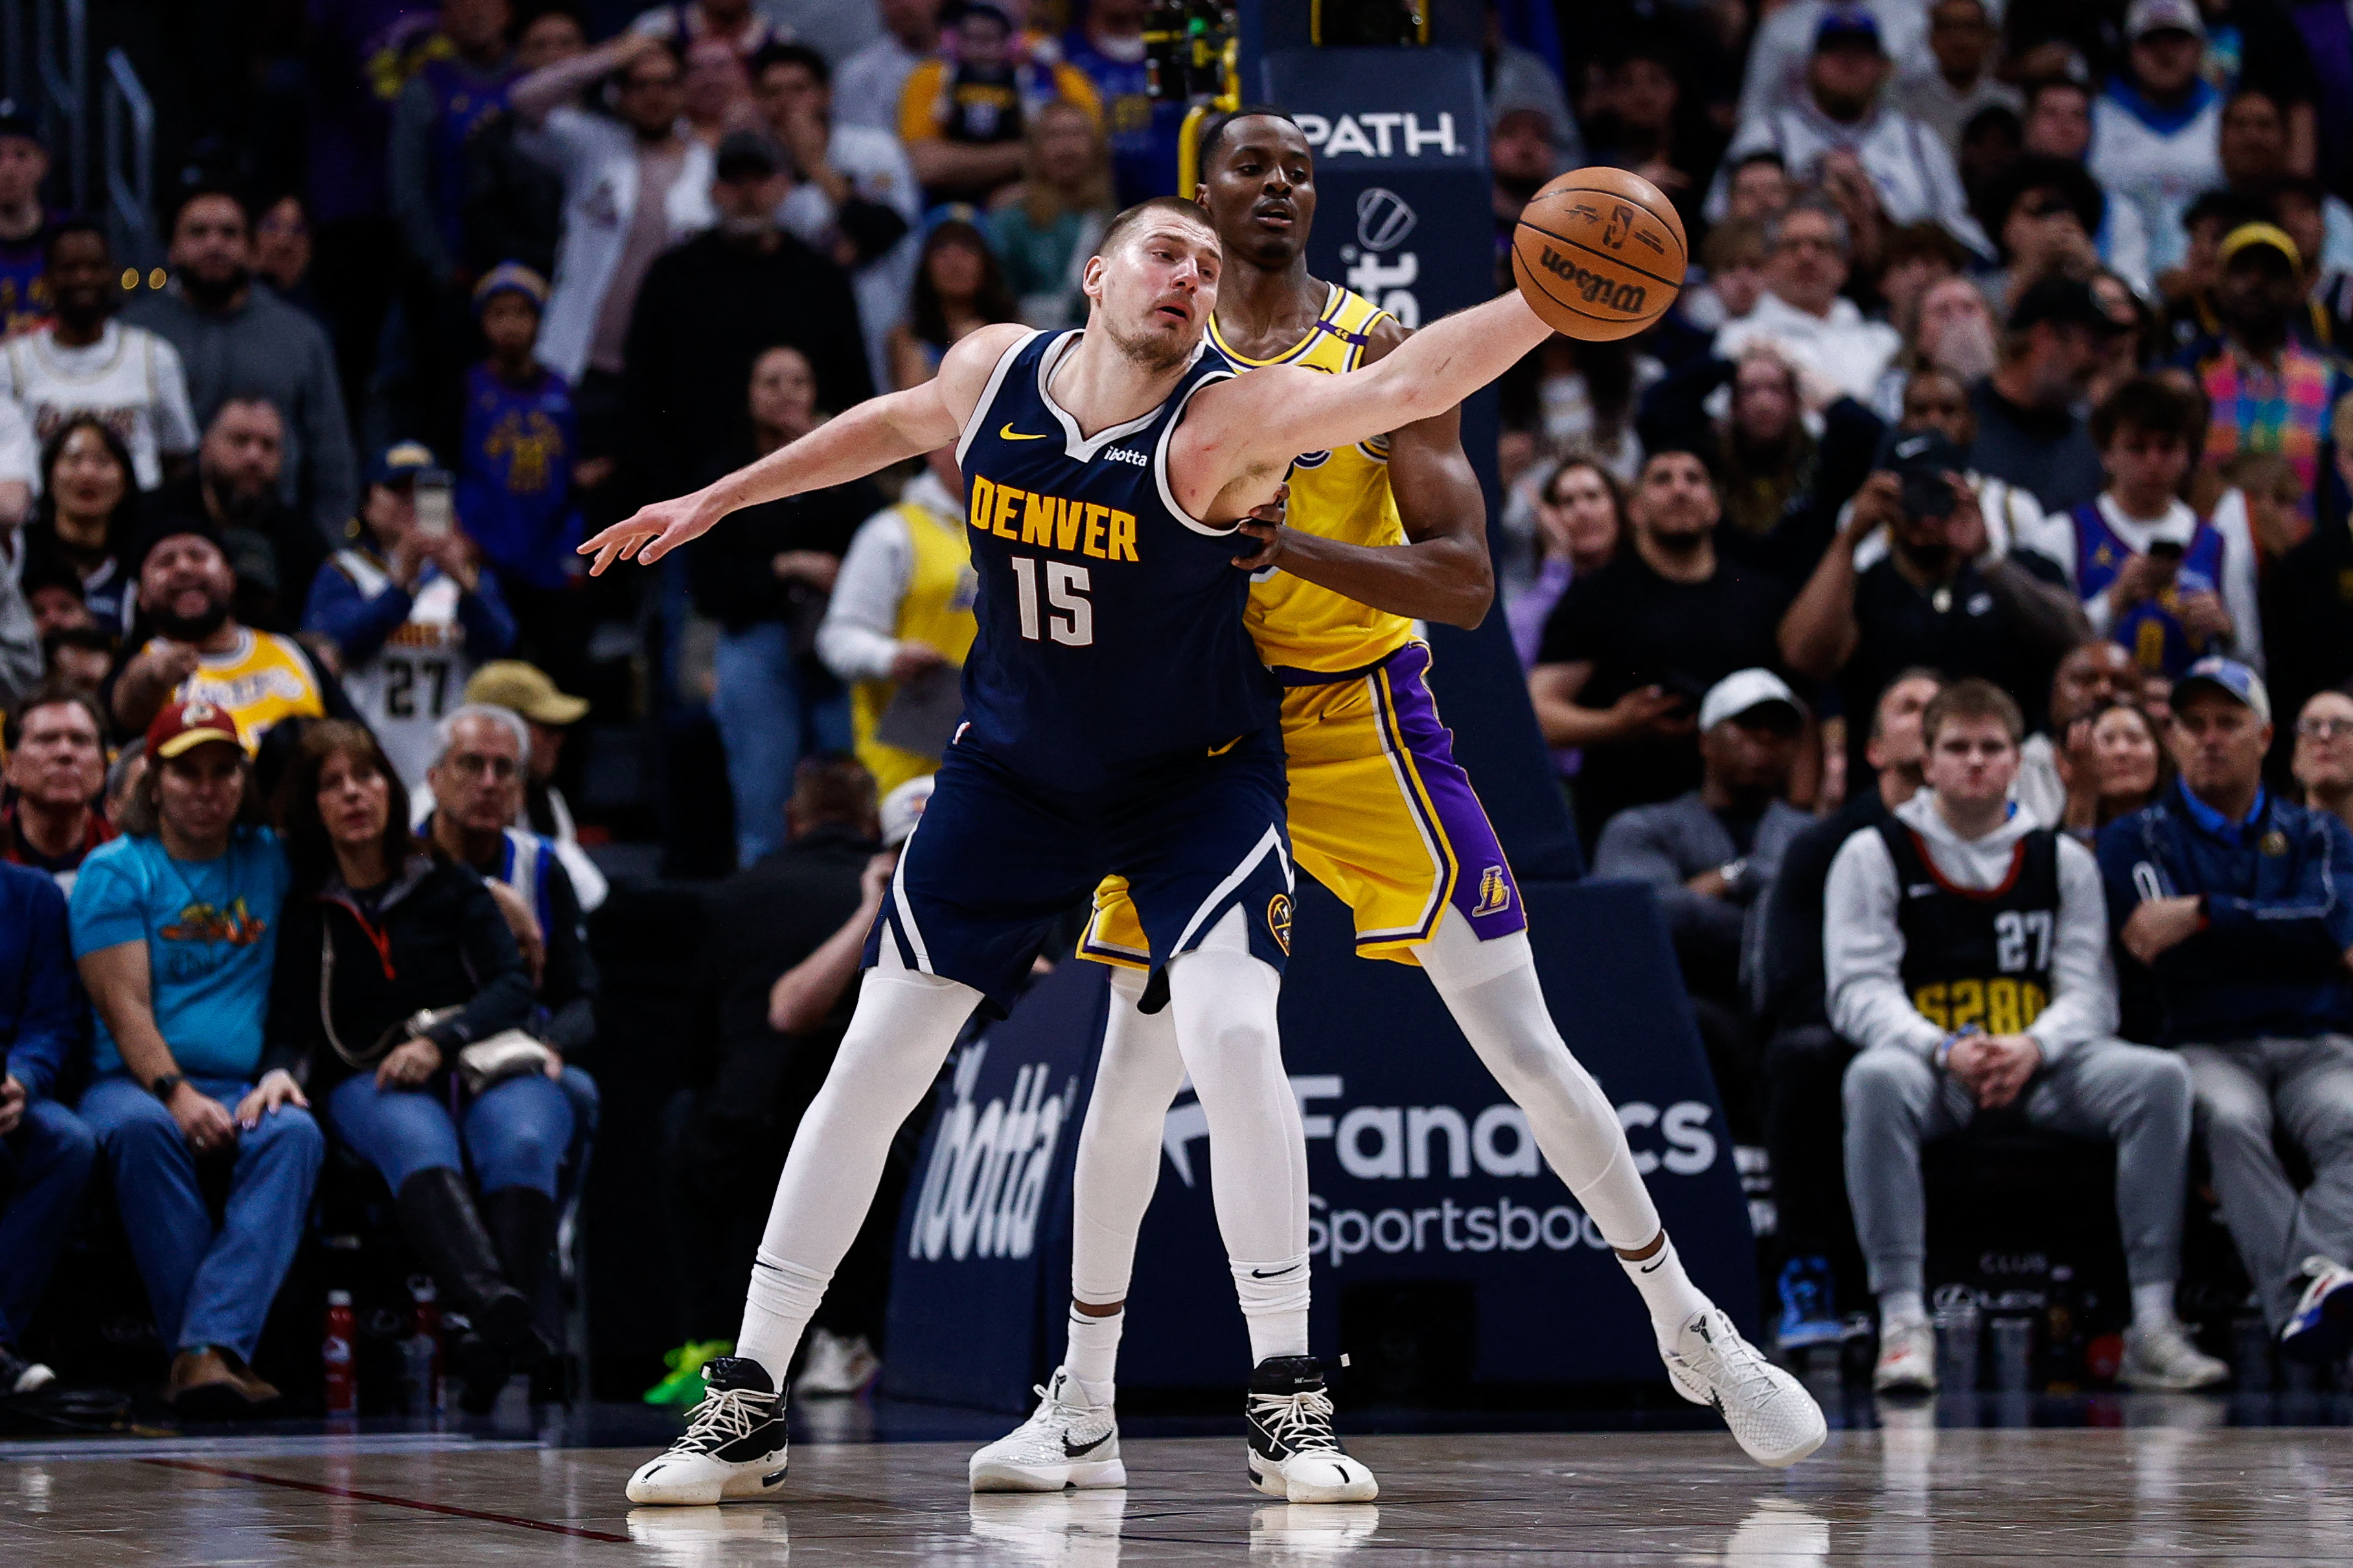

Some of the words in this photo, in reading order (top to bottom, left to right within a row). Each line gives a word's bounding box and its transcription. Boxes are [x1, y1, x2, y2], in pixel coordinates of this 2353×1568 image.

[1539, 244, 1646, 313] Wilson
[1335, 328, 1349, 340] 44
[1103, 445, 1148, 467] ibotta
[970, 473, 1140, 562] DENVER
[1011, 556, 1094, 647] 15
[387, 657, 450, 720] 27
[1993, 909, 2054, 972] 27
[908, 1039, 1062, 1262] ibotta
[1289, 1073, 1717, 1180] Fanacs
